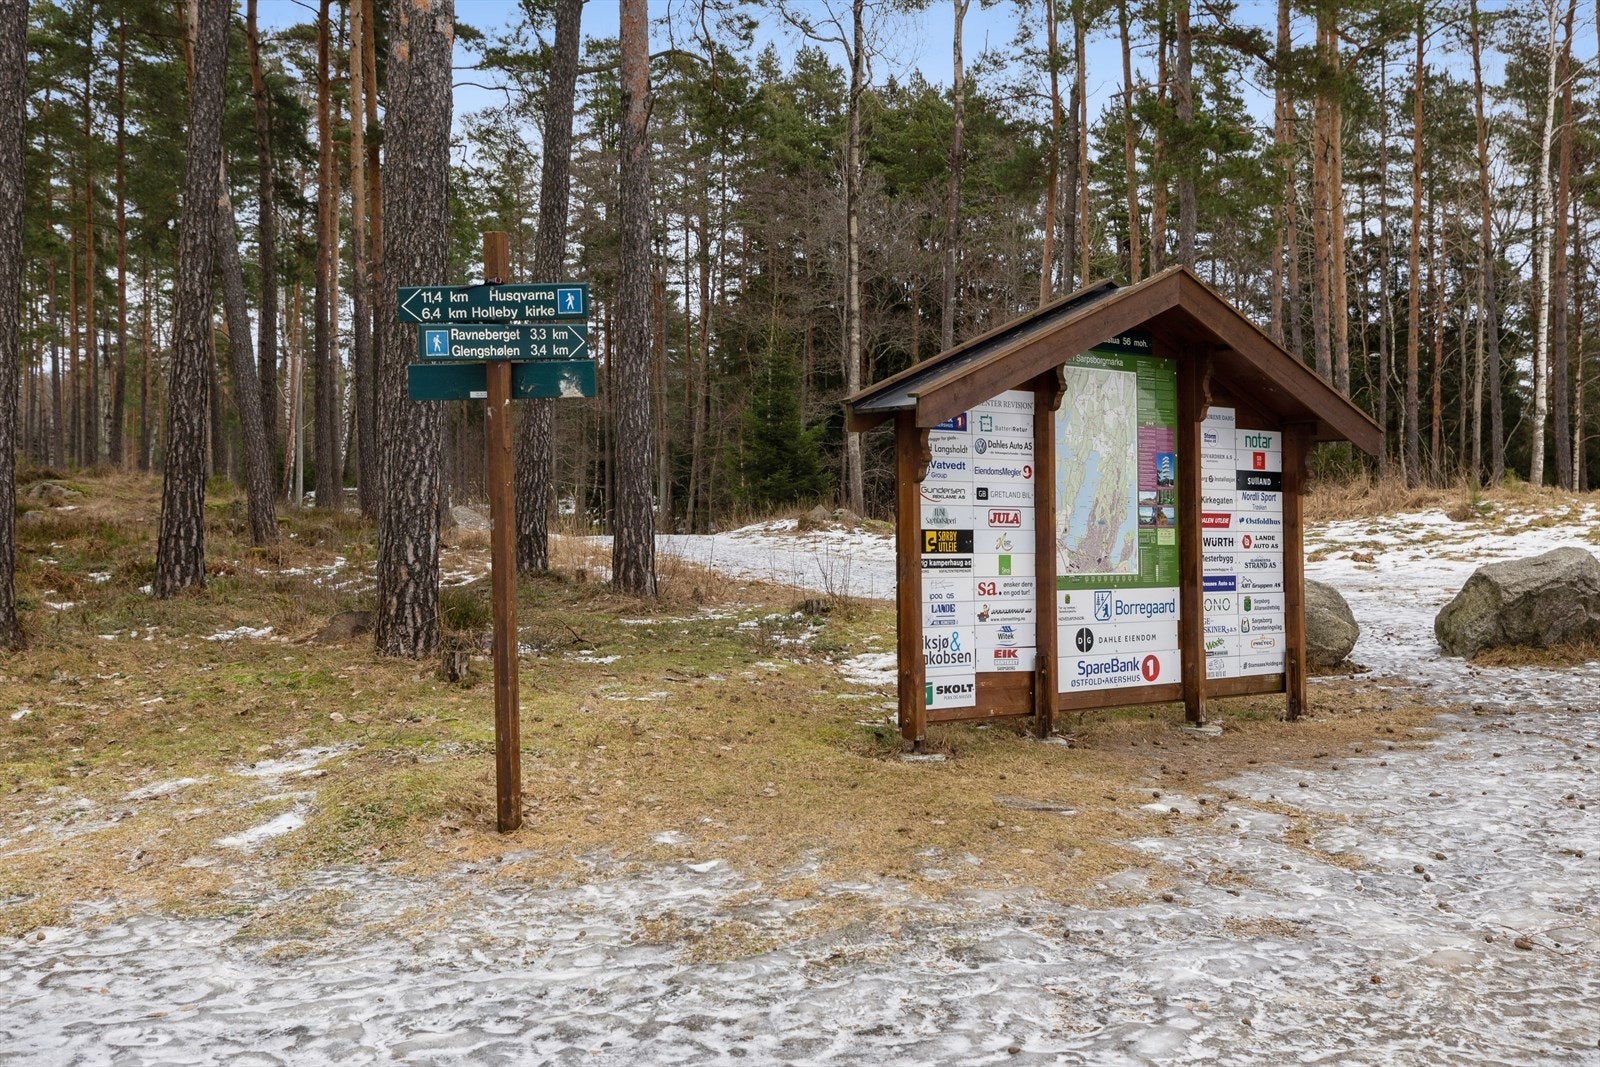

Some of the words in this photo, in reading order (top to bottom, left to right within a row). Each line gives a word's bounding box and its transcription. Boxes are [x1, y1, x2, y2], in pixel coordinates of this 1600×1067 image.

[421, 291, 442, 304] 11,4
[450, 291, 468, 303] km
[490, 290, 555, 303] Husqvarna
[422, 307, 441, 320] 6,4
[449, 307, 467, 319] km
[472, 306, 518, 319] Holleby
[526, 305, 555, 317] kirke
[451, 328, 520, 342] Ravneberget
[530, 328, 546, 341] 3,3
[553, 328, 568, 340] km
[1123, 337, 1131, 346] 56
[1134, 340, 1148, 348] moh.
[452, 345, 520, 358] Glengshølen
[531, 345, 547, 357] 3,4
[553, 345, 568, 356] km
[1076, 354, 1123, 366] Sarpsborgmarka
[988, 440, 1008, 449] Dahles
[1009, 442, 1023, 450] Auto
[1024, 442, 1033, 450] AS
[1245, 433, 1272, 448] notar
[934, 445, 968, 456] Langsholdt
[931, 460, 966, 470] Vatvedt
[921, 486, 966, 494] Gundersen
[1202, 496, 1234, 506] Kirkegaten
[1242, 492, 1260, 501] Nordli
[1260, 492, 1276, 504] Sport
[990, 513, 1020, 524] JULA
[938, 531, 957, 541] SØRBY
[938, 542, 958, 552] UTLEIE
[1011, 590, 1020, 598] god
[932, 604, 956, 613] LANDE
[1116, 598, 1175, 618] Borregaard
[950, 632, 960, 652] &
[1124, 634, 1156, 643] EIENDOM
[994, 650, 1018, 658] EIK
[1078, 657, 1140, 677] SpareBank
[936, 684, 974, 694] SKOLT
